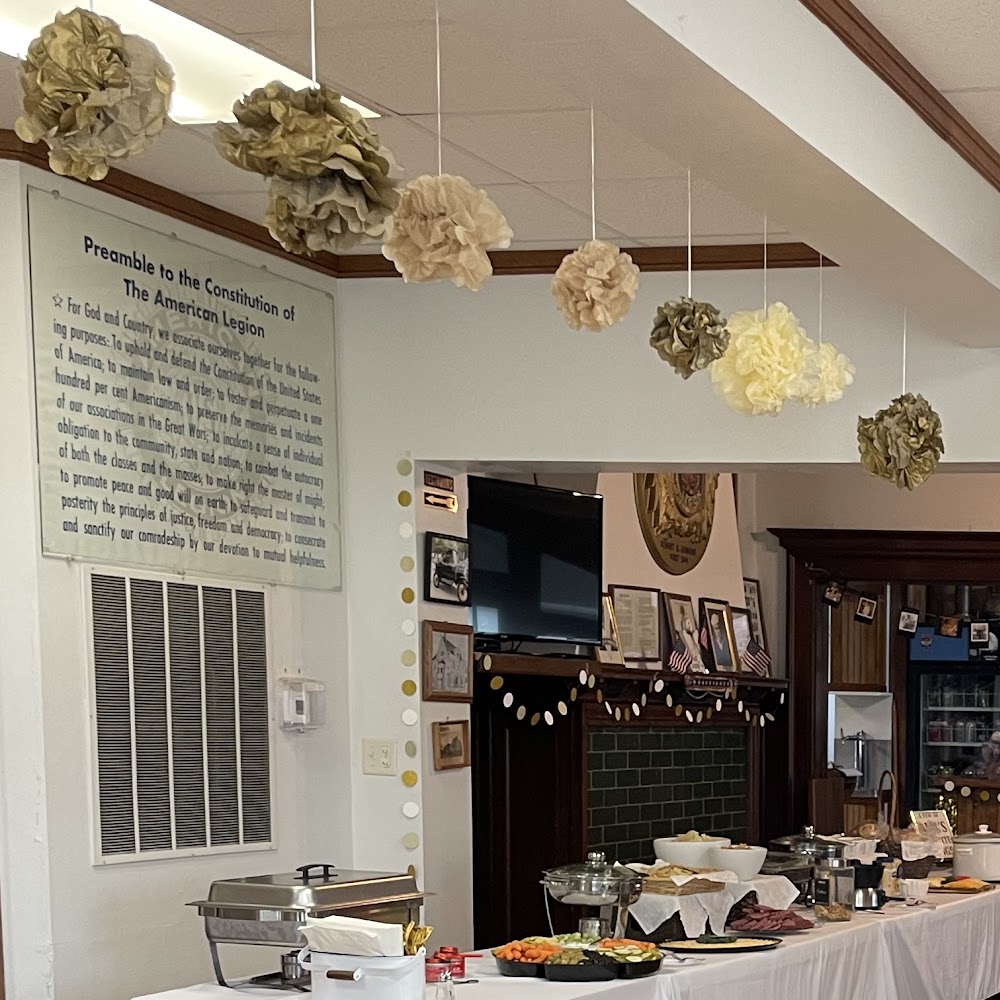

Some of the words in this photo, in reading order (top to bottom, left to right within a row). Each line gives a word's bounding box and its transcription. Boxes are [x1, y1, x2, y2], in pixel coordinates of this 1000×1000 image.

[84, 236, 154, 275] Preamble
[160, 264, 174, 281] to
[179, 268, 200, 290] the
[205, 278, 278, 316] Constitution
[284, 306, 294, 322] of
[124, 278, 150, 302] The
[154, 290, 218, 324] American
[223, 310, 264, 338] Legion
[54, 319, 66, 340] ing
[112, 334, 122, 350] To
[125, 340, 151, 358] uphold
[154, 348, 168, 363] and
[172, 350, 196, 370] defend
[200, 358, 210, 375] the
[214, 363, 254, 387] Constitution
[257, 375, 264, 389] of
[266, 377, 277, 393] the
[280, 382, 300, 400] United
[302, 388, 321, 405] States
[68, 297, 81, 314] For
[84, 302, 100, 320] God
[104, 310, 120, 326] and
[158, 328, 169, 340] we
[173, 331, 205, 352] associate
[208, 342, 240, 361] ourselves
[244, 352, 270, 370] together
[274, 357, 283, 373] for
[286, 362, 296, 377] the
[54, 343, 64, 360] of
[108, 359, 116, 374] to
[120, 364, 154, 383] maintain
[158, 369, 172, 386] law
[176, 377, 190, 392] and
[217, 388, 224, 400] to
[228, 388, 248, 406] foster
[250, 396, 262, 411] and
[266, 402, 300, 420] perpetuate
[304, 412, 308, 422] a
[311, 415, 322, 426] one
[55, 366, 90, 390] hundred
[95, 382, 108, 396] per
[112, 386, 128, 400] cent
[186, 402, 194, 415] to
[198, 407, 227, 424] preserve
[230, 412, 241, 426] the
[245, 418, 276, 436] memories
[280, 426, 292, 439] and
[296, 430, 322, 446] incidents
[56, 392, 65, 409] of
[70, 400, 82, 412] our
[87, 404, 134, 424] associations
[138, 412, 145, 426] in
[148, 414, 162, 430] the
[165, 418, 185, 436] Great
[212, 431, 220, 443] to
[224, 432, 252, 450] inculcate
[256, 442, 260, 452] a
[264, 444, 280, 457] sense
[284, 445, 290, 459] of
[293, 448, 323, 466] individual
[58, 417, 100, 439] obligation
[104, 429, 112, 442] to
[116, 429, 128, 446] the
[180, 446, 198, 460] state
[202, 450, 214, 464] and
[246, 460, 252, 472] to
[256, 462, 278, 477] combat
[282, 466, 292, 480] the
[294, 472, 324, 490] autocracy
[59, 442, 68, 458] of
[71, 442, 90, 462] both
[94, 448, 107, 466] the
[112, 452, 137, 471] classes
[142, 459, 156, 474] and
[160, 461, 172, 478] the
[206, 474, 213, 486] to
[216, 475, 236, 490] make
[239, 480, 255, 496] right
[258, 481, 268, 497] the
[272, 488, 292, 500] master
[296, 490, 302, 503] of
[60, 468, 69, 482] to
[74, 473, 108, 489] promote
[112, 480, 134, 494] peace
[138, 482, 152, 496] and
[156, 486, 174, 502] good
[178, 488, 191, 504] will
[195, 495, 204, 506] on
[230, 500, 237, 512] to
[240, 500, 272, 518] safeguard
[276, 508, 287, 522] and
[291, 511, 316, 526] transmit
[319, 517, 326, 528] to
[61, 496, 98, 515] posterity
[102, 498, 116, 514] the
[120, 503, 156, 521] principles
[160, 506, 166, 522] of
[198, 514, 227, 531] freedom
[230, 520, 243, 534] and
[286, 531, 291, 542] to
[294, 533, 326, 548] consecrate
[62, 517, 78, 532] and
[84, 521, 116, 541] sanctify
[121, 528, 134, 540] our
[138, 530, 185, 550] comradeship
[190, 534, 198, 552] by
[204, 540, 214, 551] our
[220, 538, 249, 557] devotion
[253, 546, 260, 558] to
[264, 548, 286, 562] mutual
